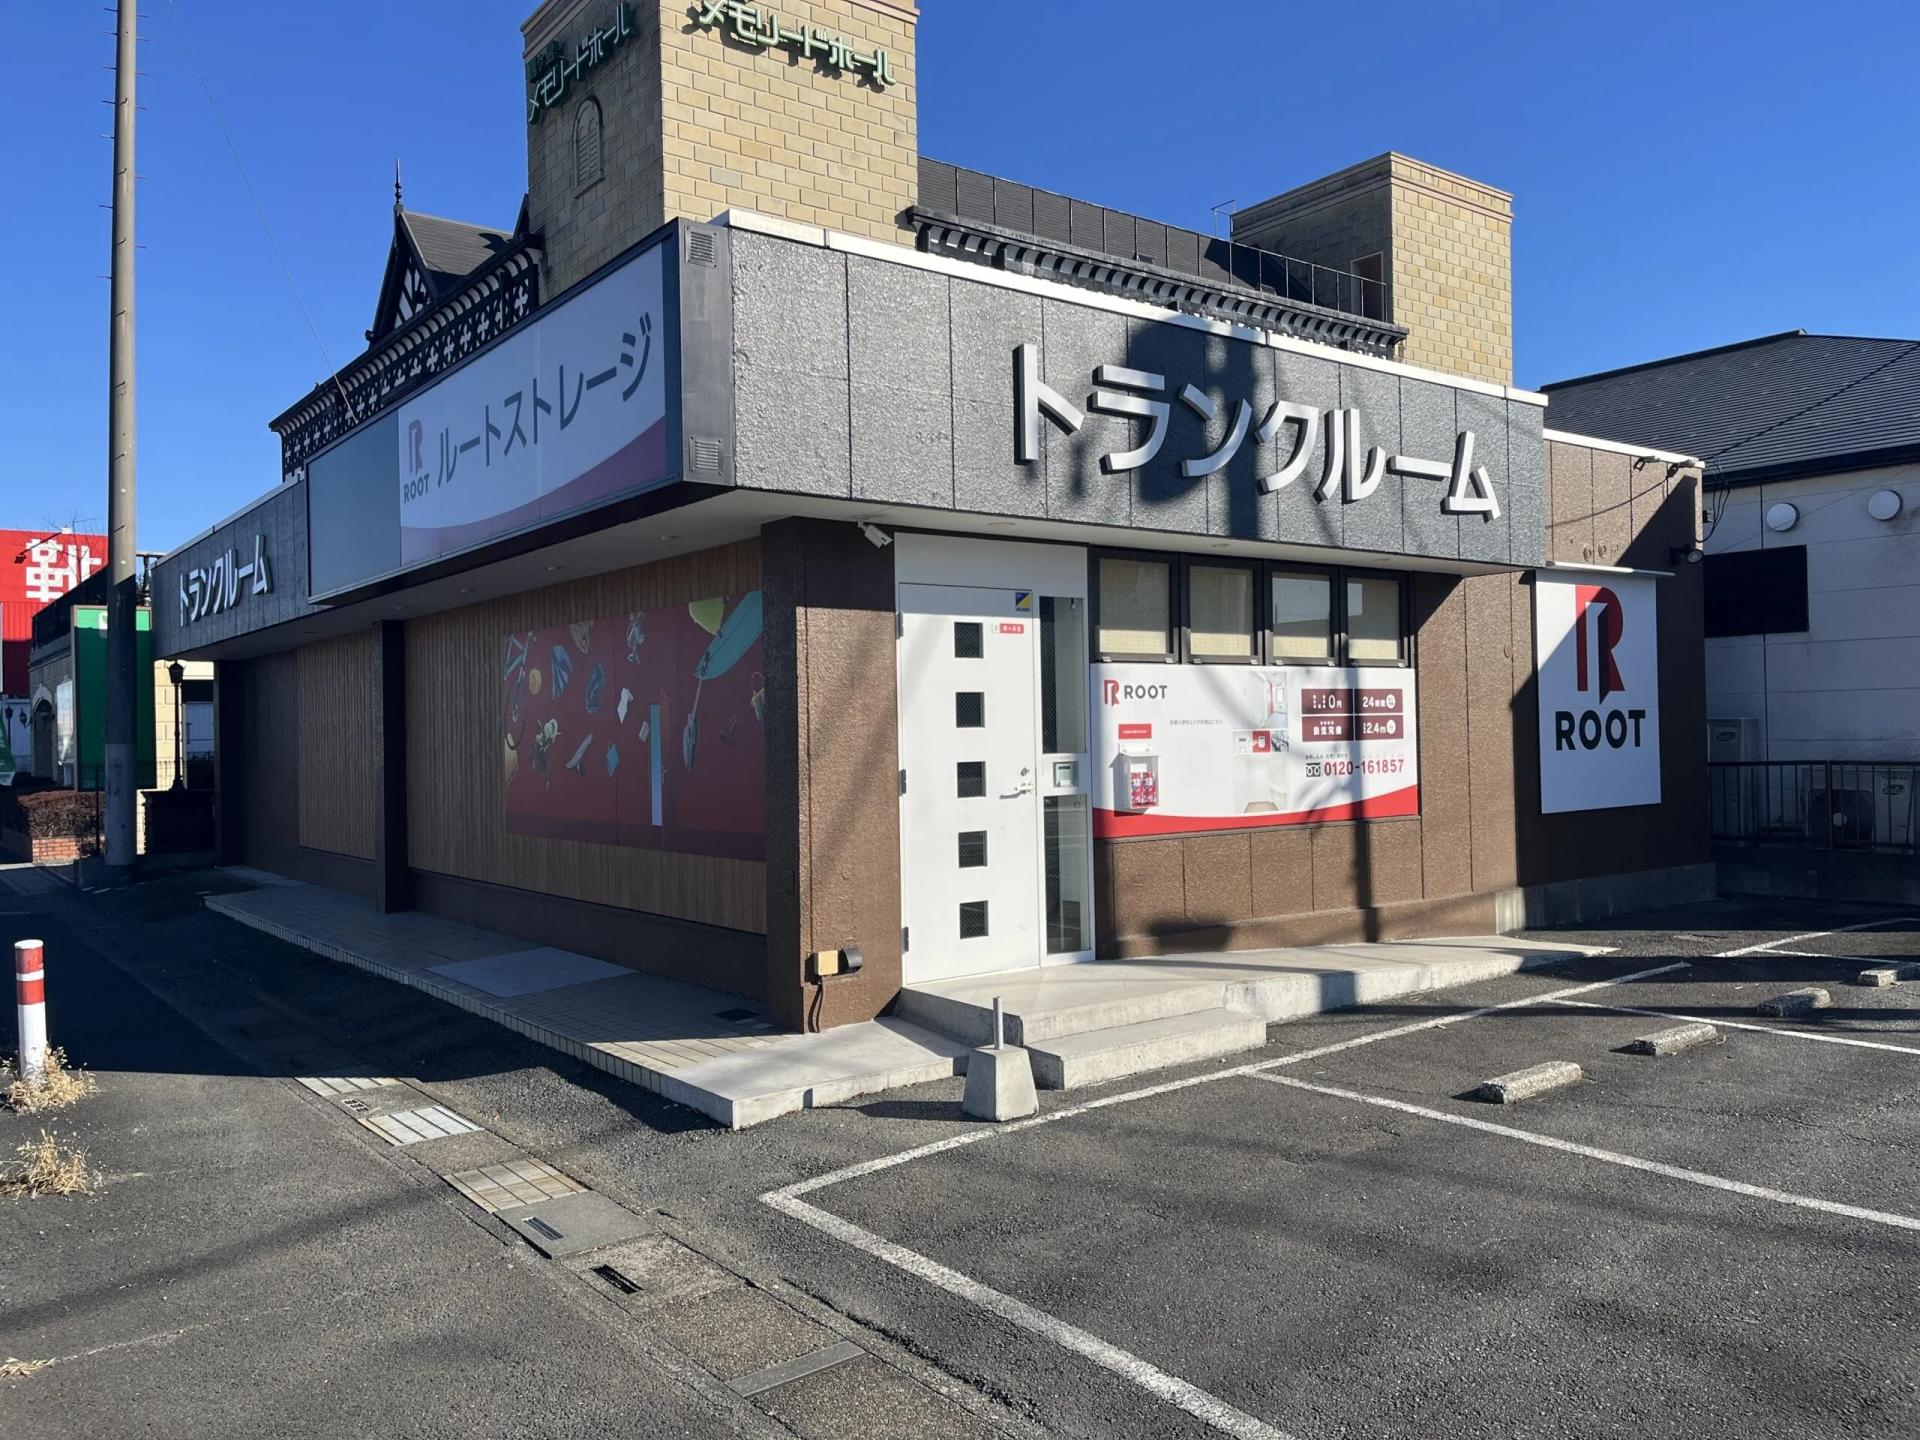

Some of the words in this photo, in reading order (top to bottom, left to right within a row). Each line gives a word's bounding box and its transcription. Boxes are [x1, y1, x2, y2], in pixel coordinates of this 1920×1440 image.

[528, 1, 632, 122] メモリードホール
[699, 0, 897, 86] メモリードホール
[437, 311, 652, 488] ルートストレージ
[1014, 343, 1501, 523] トランクルーム
[403, 473, 431, 503] ROOT
[179, 534, 272, 627] トランクルーム
[1123, 685, 1168, 699] ROOT
[1555, 708, 1646, 751] ROOT
[1324, 759, 1405, 776] 0120-161857
